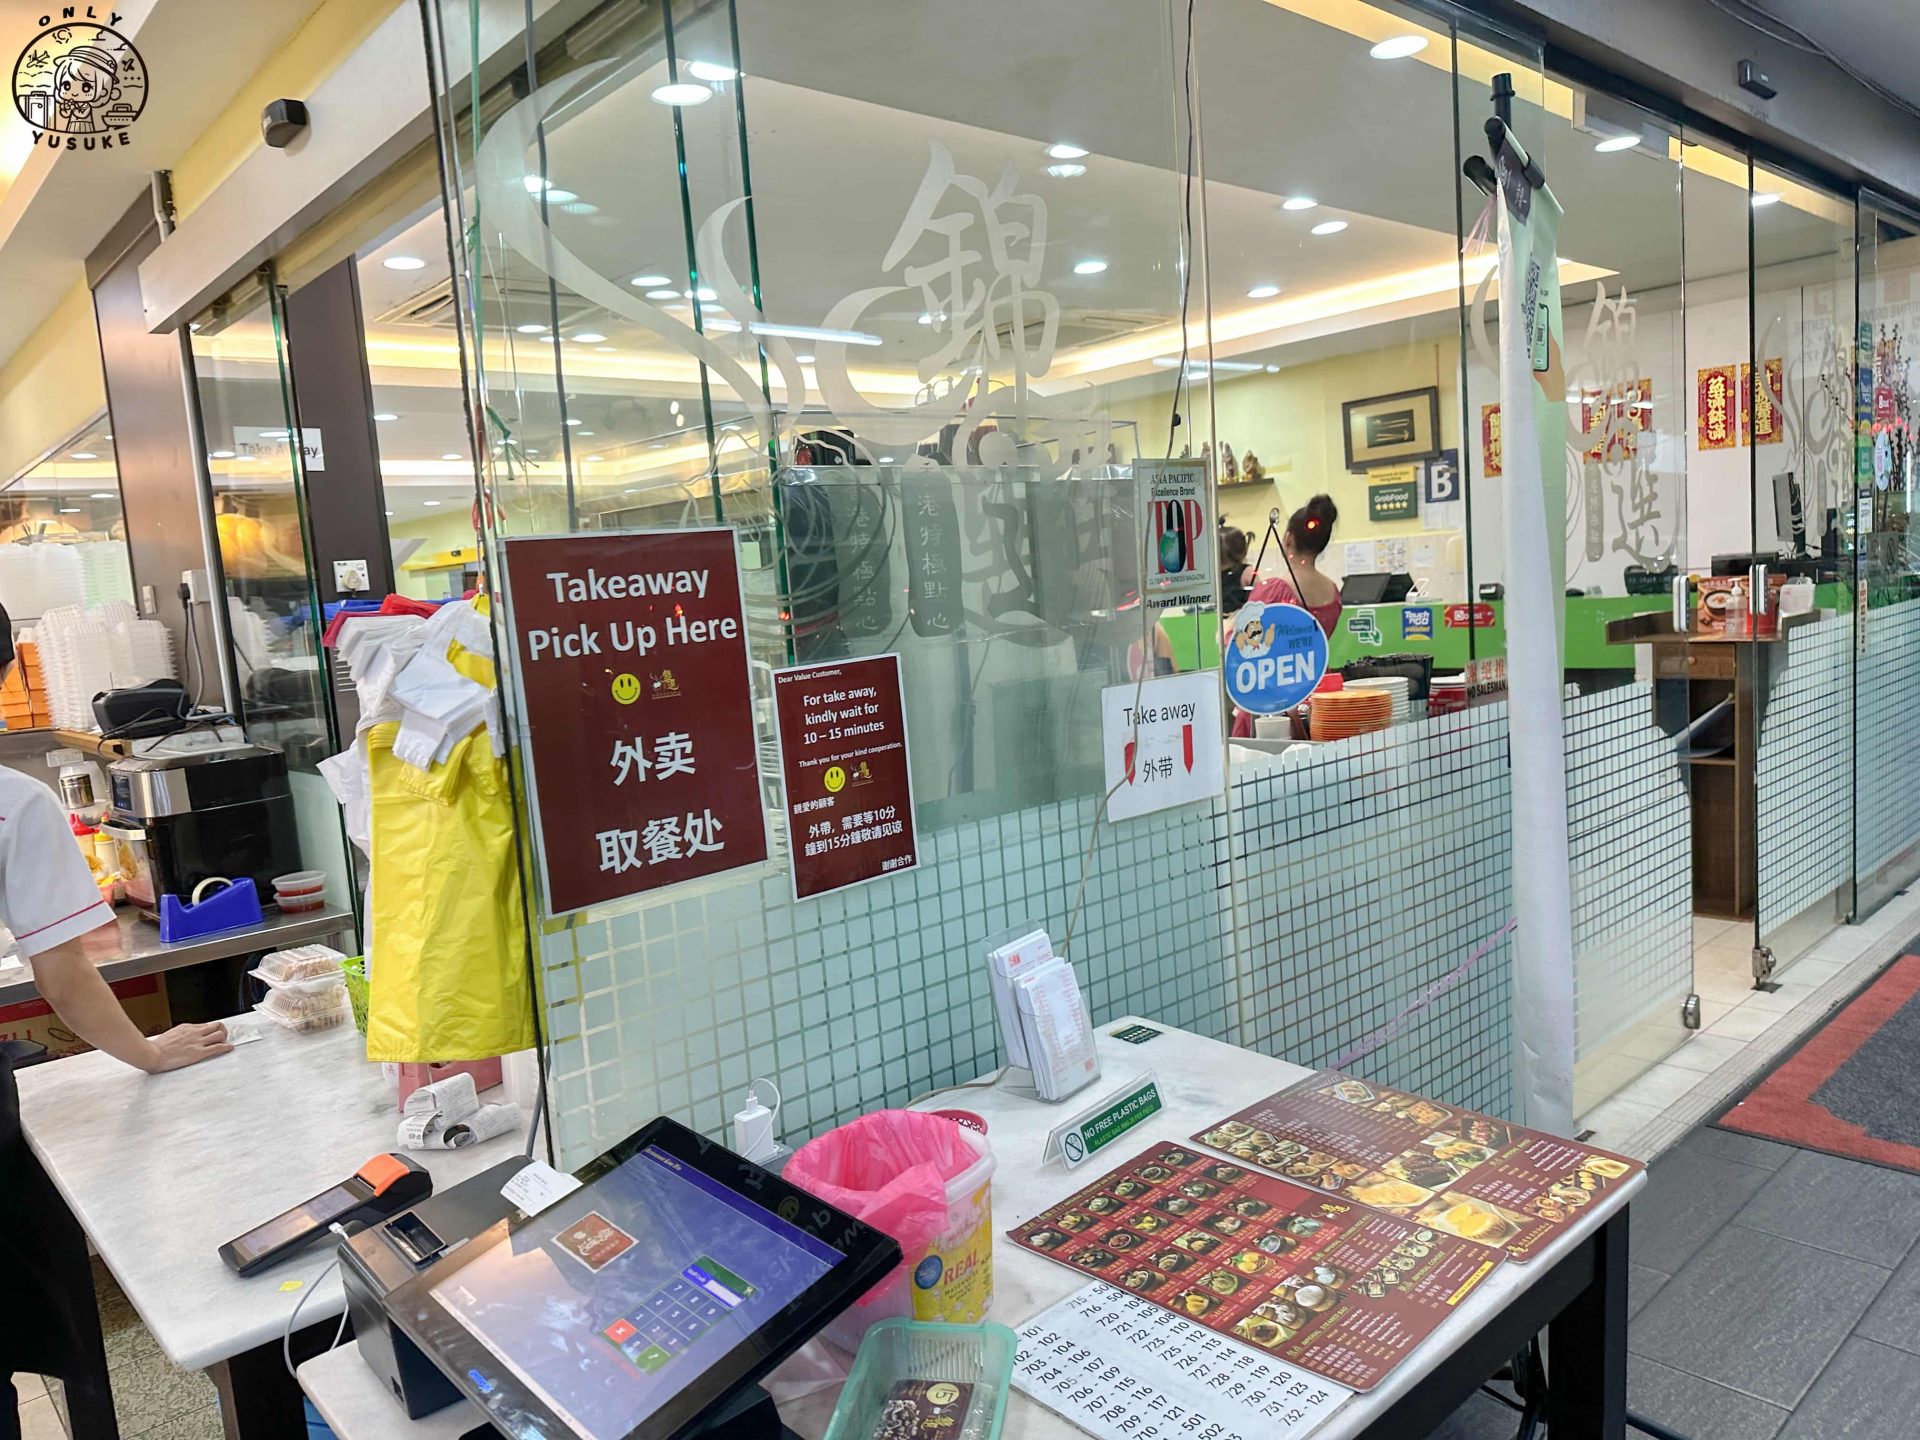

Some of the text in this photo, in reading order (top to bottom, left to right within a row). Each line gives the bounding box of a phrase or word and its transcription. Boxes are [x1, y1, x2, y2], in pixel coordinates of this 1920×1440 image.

[240, 442, 271, 455] Take
[1168, 473, 1195, 484] PACIFIC
[1179, 487, 1195, 496] Brand
[1147, 499, 1203, 575] TOP
[546, 568, 709, 603] Takeaway
[1146, 593, 1212, 609] Award Winner
[528, 616, 737, 661] Pick Up Here
[778, 669, 842, 684] Dear Value Customer,
[1235, 650, 1315, 694] OPEN
[803, 686, 877, 707] For take away,
[1467, 686, 1476, 699] NO
[805, 702, 879, 726] kindly wait for
[1123, 701, 1196, 727] Take away
[803, 732, 817, 745] 10
[829, 728, 841, 740] 15
[844, 721, 885, 737] minutes
[609, 731, 696, 787] 外卖
[798, 741, 903, 768] Thank you for your kind cooperation.
[1143, 756, 1174, 783] 外带
[595, 808, 725, 875] 取餐处
[1084, 1089, 1156, 1140] NO FREE PLASTIC BAGS
[1066, 1284, 1113, 1310] 715 50
[1079, 1305, 1102, 1318] 716
[1022, 1326, 1043, 1338] 101
[1096, 1312, 1119, 1327] 720
[1110, 1306, 1159, 1335] 721 105
[1126, 1312, 1176, 1344] 722 108
[1038, 1332, 1061, 1346] 102
[1141, 1321, 1190, 1353] 723 110
[1157, 1329, 1207, 1361] 725 112
[1021, 1340, 1076, 1375] 703 104
[1036, 1350, 1091, 1384] 704 106
[1173, 1338, 1222, 1371] 726 113
[1188, 1348, 1237, 1380] 727 114
[1052, 1357, 1105, 1394] 705 107
[1067, 1366, 1121, 1403] 706 109
[1205, 1356, 1255, 1389] 728 118
[1222, 1365, 1271, 1399] 729 119
[1083, 1376, 1136, 1414] 707 115
[1099, 1385, 1153, 1423] 708 116
[1241, 1371, 1292, 1408] 730 120
[1260, 1382, 1309, 1417] 731 123
[1116, 1394, 1168, 1433] 709 117
[1132, 1405, 1185, 1440] 710 121
[1181, 1413, 1206, 1432] 501
[1279, 1390, 1329, 1427] 732 124
[1198, 1423, 1226, 1440] 502
